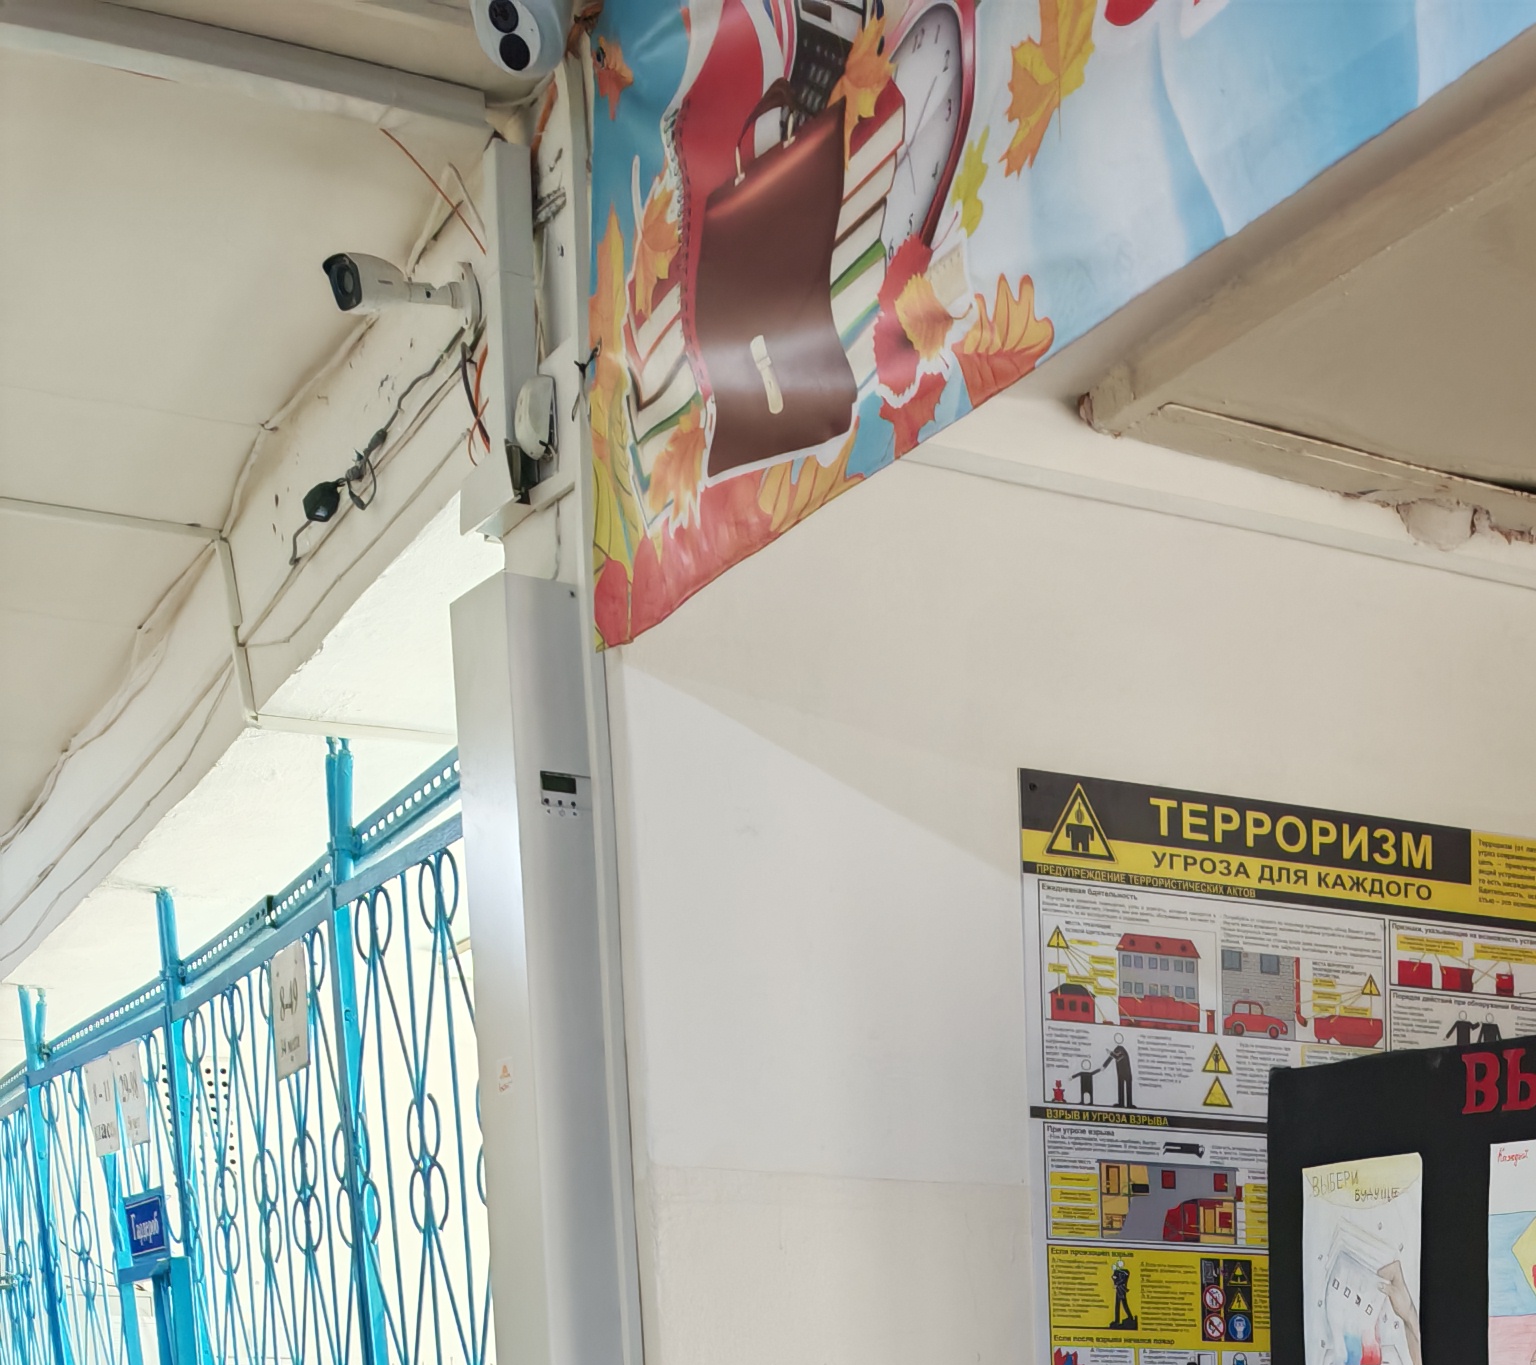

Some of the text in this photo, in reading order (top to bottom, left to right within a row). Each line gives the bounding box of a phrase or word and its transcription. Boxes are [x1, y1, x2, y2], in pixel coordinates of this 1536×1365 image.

[1149, 796, 1434, 870] ТЕРРОРИЗМ
[1036, 863, 1256, 898] ПРЕДУПРЕЖДЕНИЕ ТЕРРОРИСТИЧЕСКИХ АКТОВ
[1152, 851, 1432, 902] УГРОЗА ДЛЯ КАЖДОГО
[1046, 1108, 1169, 1127] ВЗРЫВ И УГРОЗА ВЗРЫВА
[1047, 1125, 1061, 1134] При
[1312, 1170, 1359, 1198] ВЫБЕРИ
[130, 1211, 159, 1246] Гардероб
